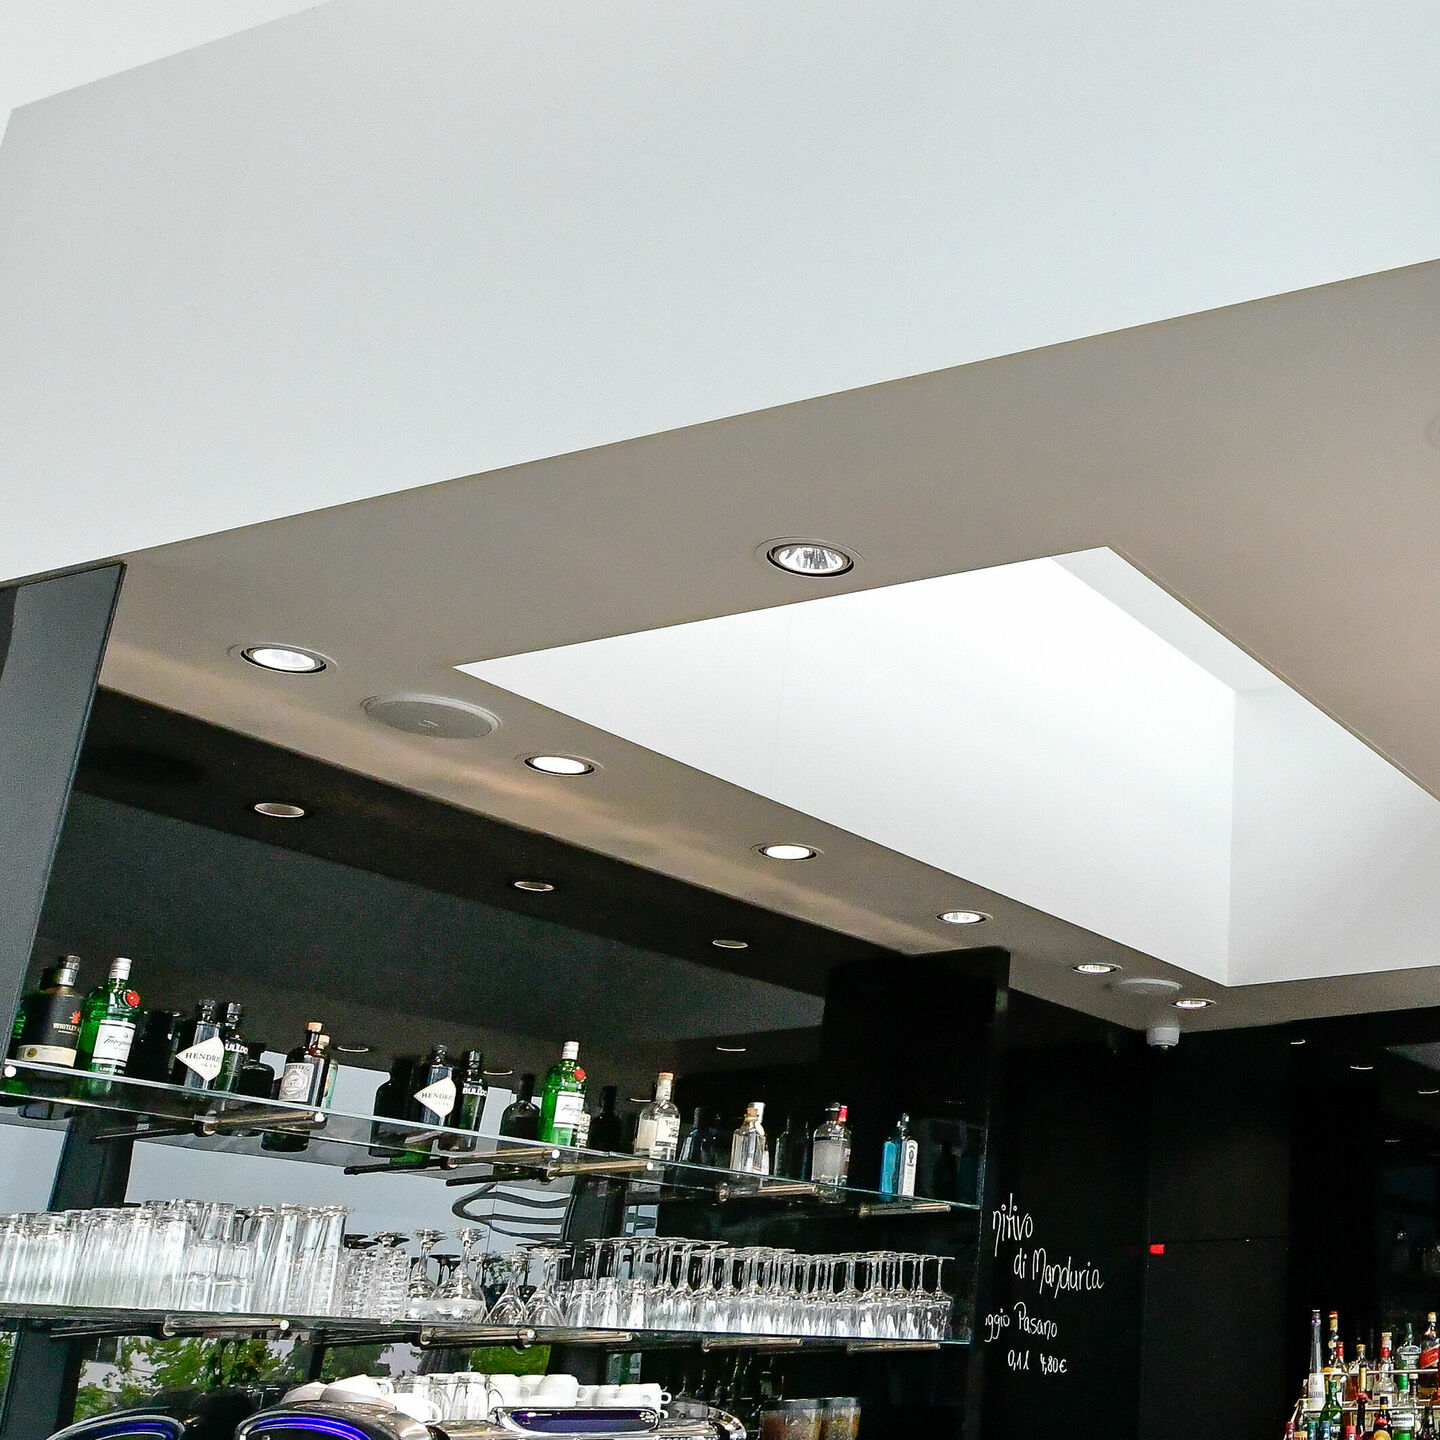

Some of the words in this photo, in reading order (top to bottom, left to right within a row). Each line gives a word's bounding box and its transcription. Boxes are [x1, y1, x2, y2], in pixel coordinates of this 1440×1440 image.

[1013, 1247, 1028, 1279] di
[1032, 1247, 1105, 1299] Manduria
[1013, 1301, 1058, 1341] Pasano
[1040, 1353, 1068, 1375] 4,80€
